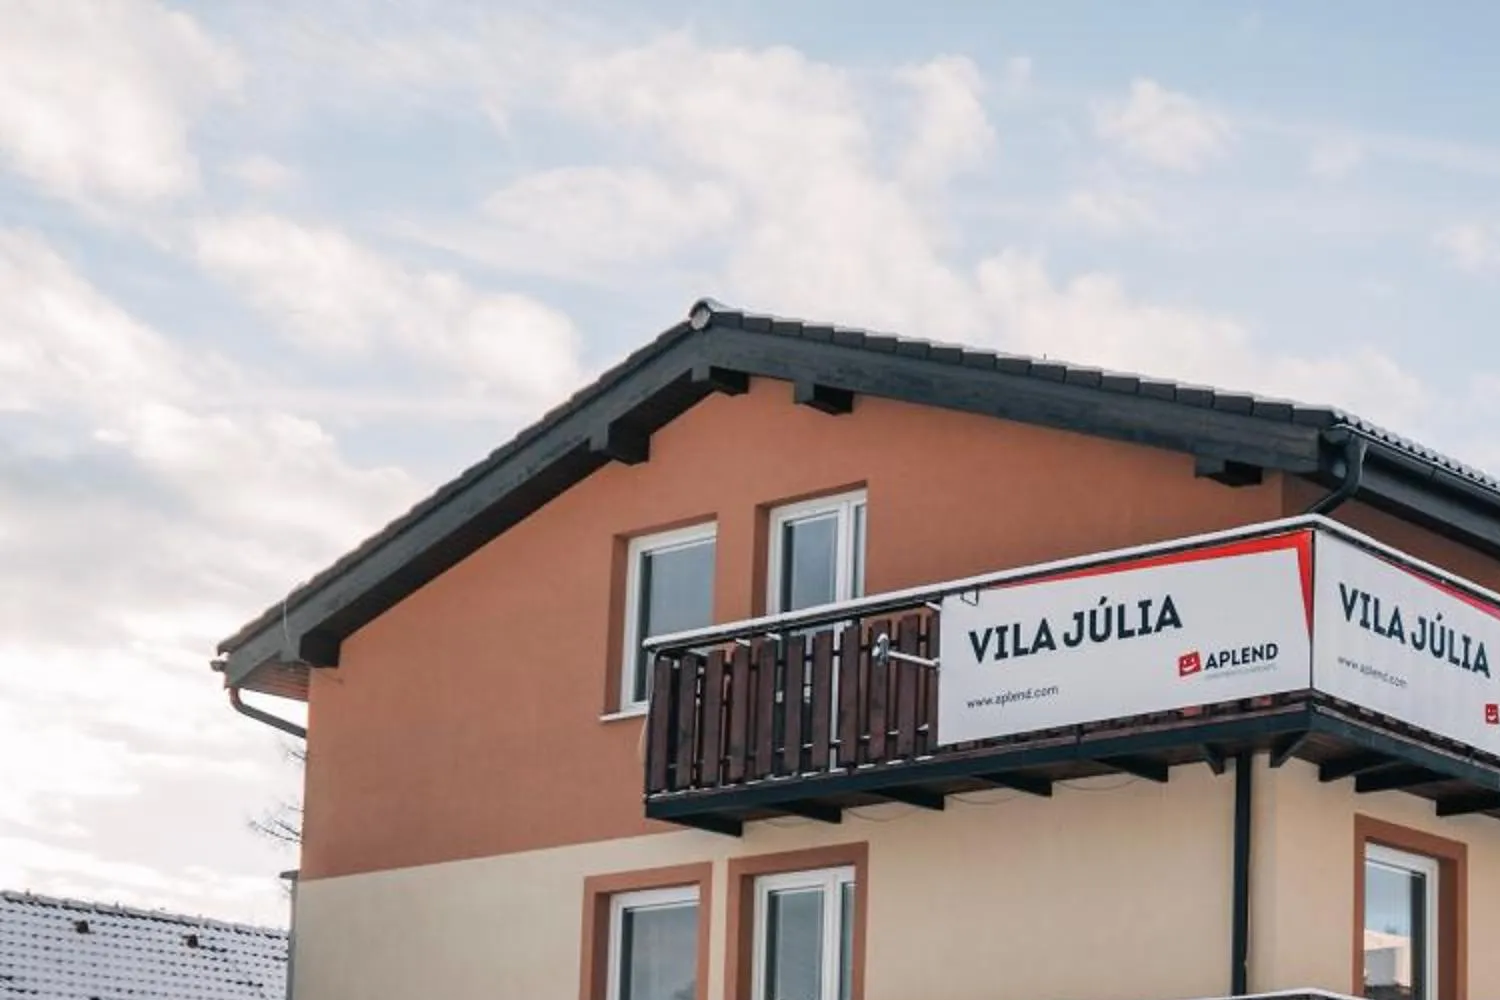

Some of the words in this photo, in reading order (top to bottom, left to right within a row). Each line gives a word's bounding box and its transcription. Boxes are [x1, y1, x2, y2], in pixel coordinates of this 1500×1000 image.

[968, 617, 1057, 664] VILA
[1063, 595, 1183, 649] JÚLIA
[1338, 581, 1407, 645] VILA
[1410, 612, 1491, 679] JÚLIA
[1204, 643, 1279, 671] APLEND
[966, 685, 1059, 709] www.aplend.com
